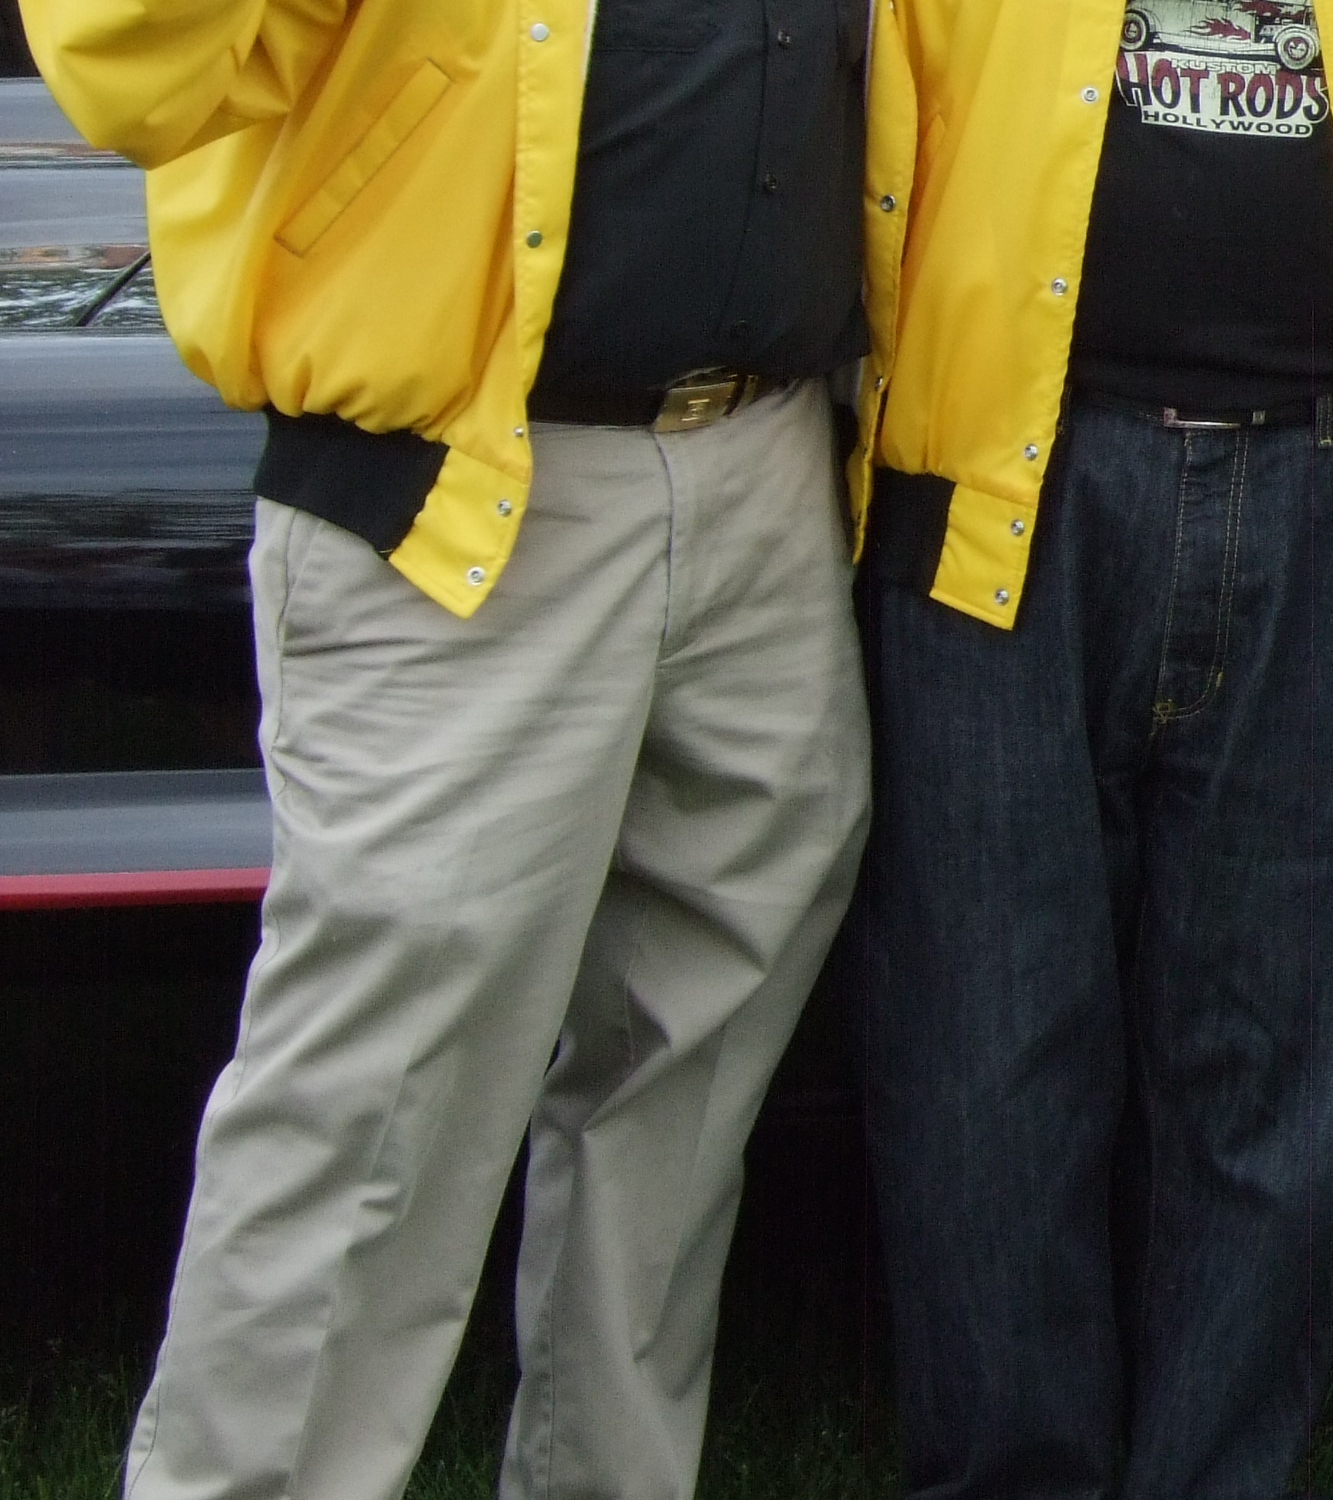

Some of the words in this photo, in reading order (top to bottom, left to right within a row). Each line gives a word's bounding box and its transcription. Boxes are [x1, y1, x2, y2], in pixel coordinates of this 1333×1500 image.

[1171, 58, 1282, 77] KUSTOM
[1115, 52, 1210, 113] HOT
[1216, 70, 1329, 122] RODS
[1143, 110, 1311, 136] HOLLYWOOD
